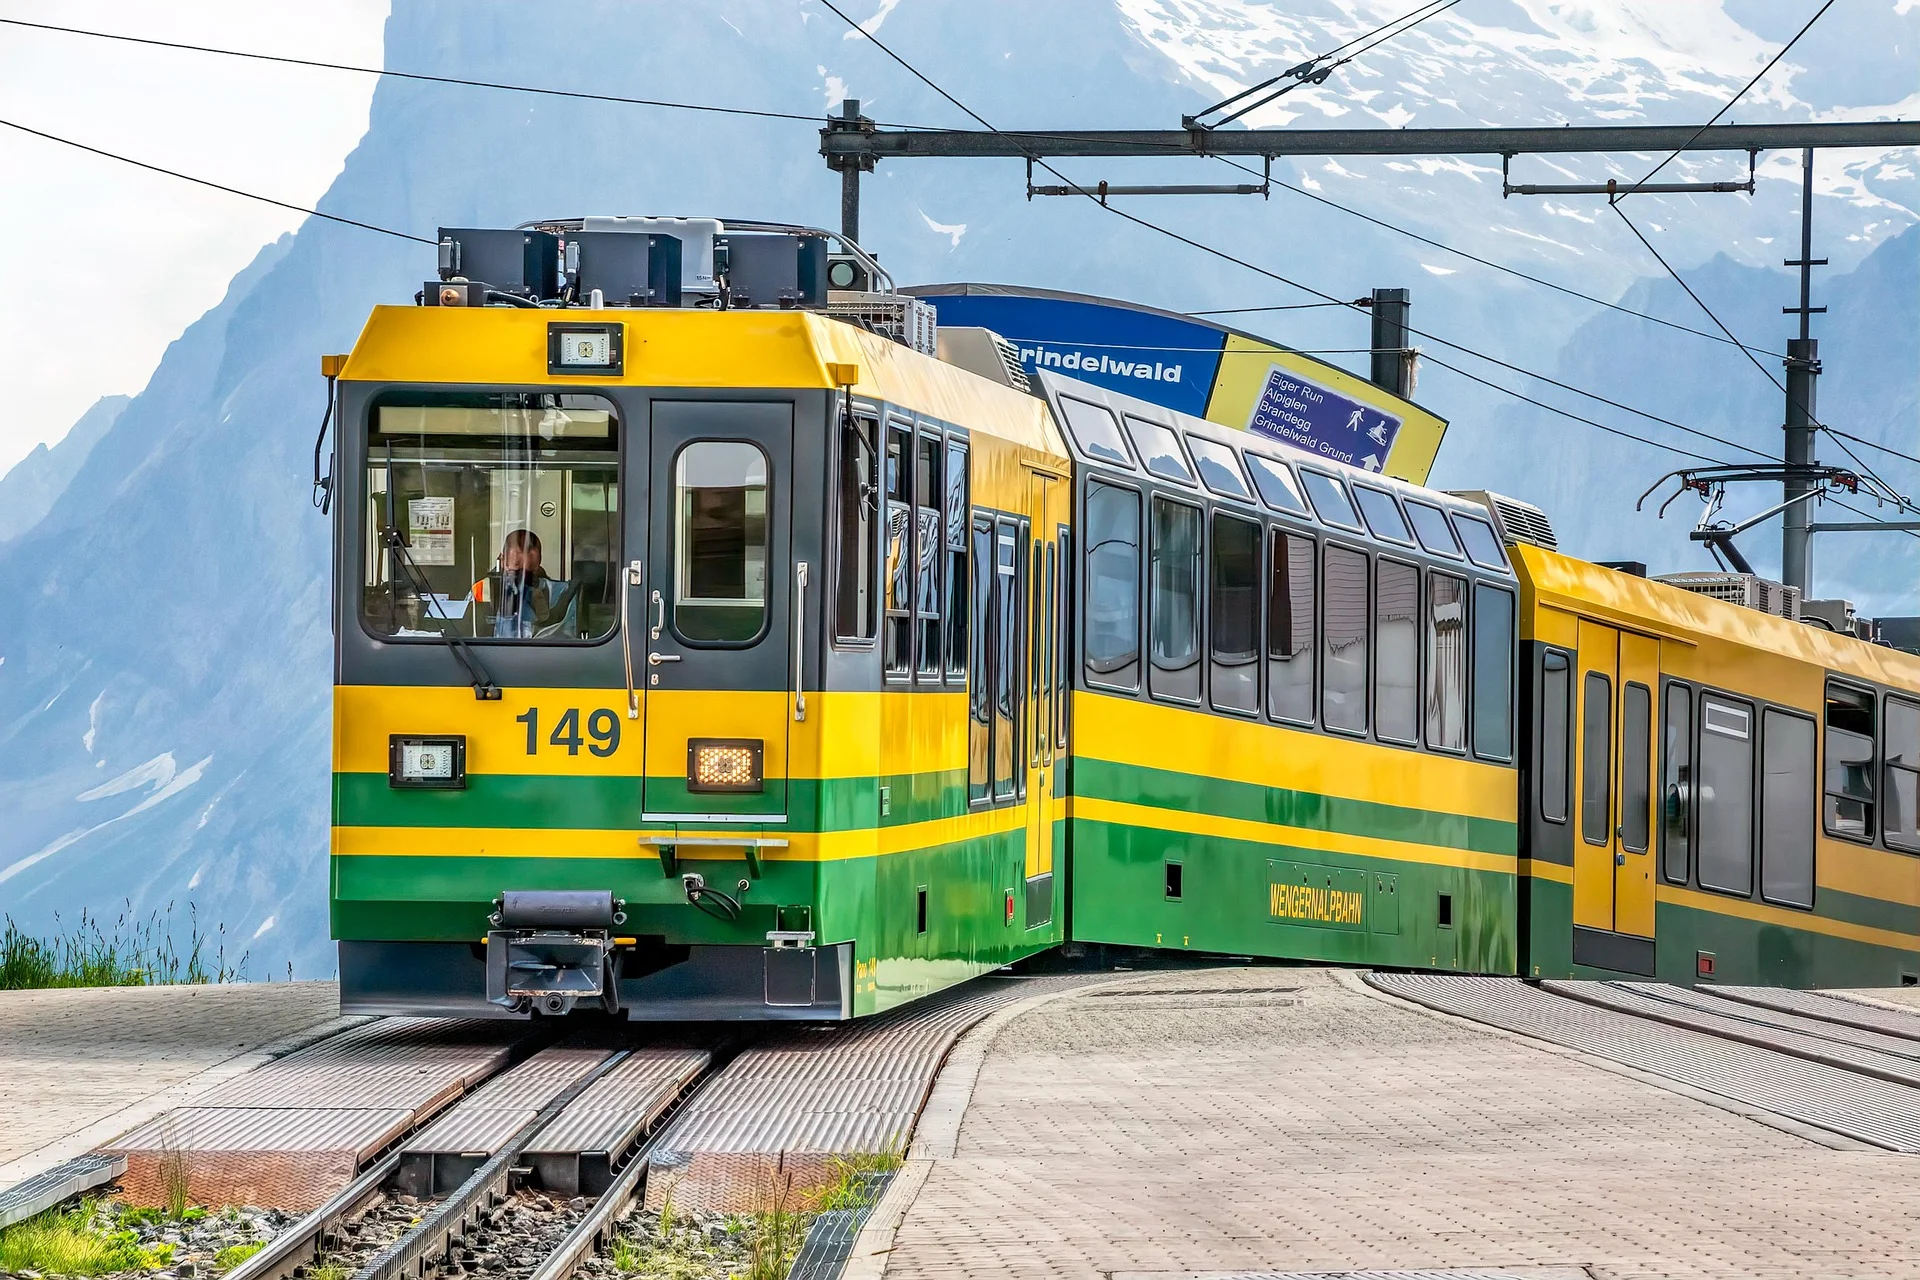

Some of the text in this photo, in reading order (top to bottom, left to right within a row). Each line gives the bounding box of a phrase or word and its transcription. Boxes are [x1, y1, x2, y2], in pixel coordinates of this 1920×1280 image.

[1264, 387, 1308, 413] Alpiglen
[1270, 373, 1324, 404] Eiger Run
[1259, 400, 1312, 432] Brandegg
[1254, 414, 1353, 463] Grindelwald Grund
[516, 707, 621, 757] 149
[1270, 883, 1362, 924] WENGERNALPBAHN
